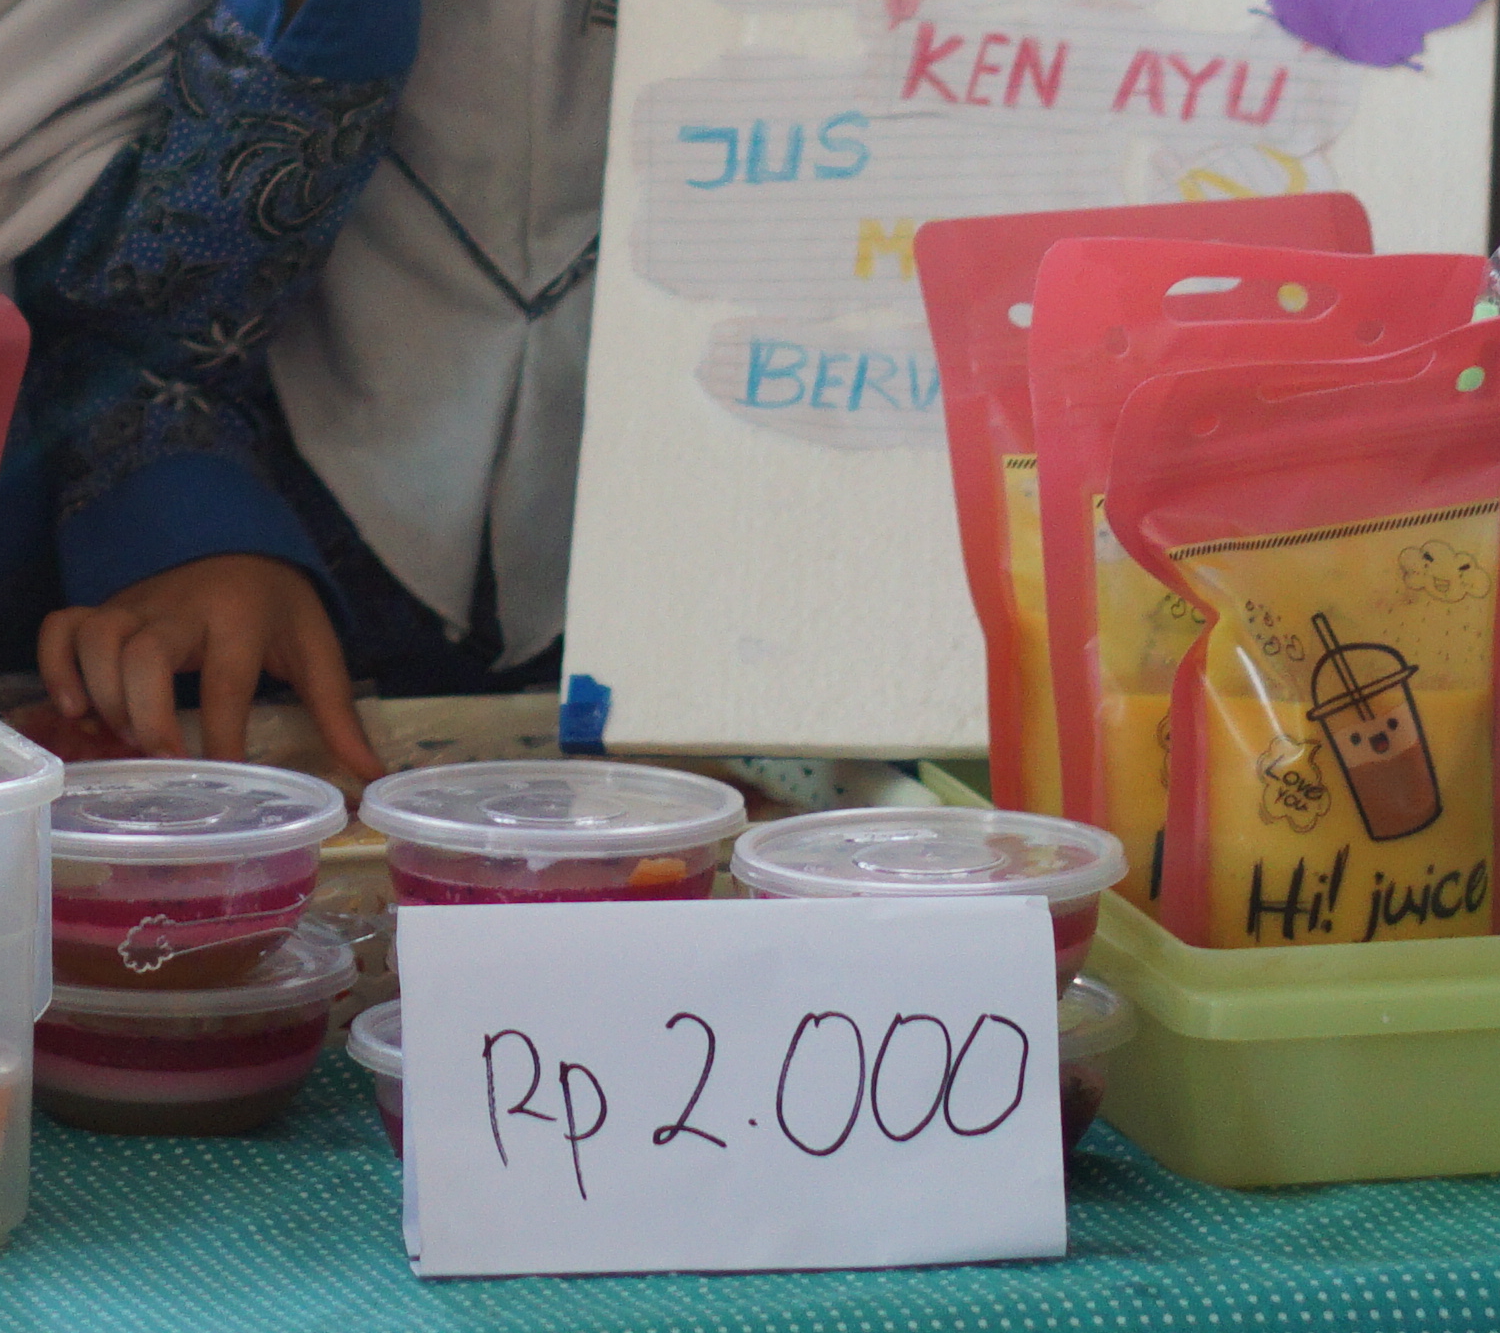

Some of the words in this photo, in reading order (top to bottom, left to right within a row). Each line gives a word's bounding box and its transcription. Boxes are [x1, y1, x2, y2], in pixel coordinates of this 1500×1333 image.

[901, 21, 1069, 109] KEN
[1112, 49, 1290, 127] AYU
[678, 110, 872, 190] JUS
[736, 337, 940, 412] BERV
[1246, 843, 1350, 943] Hi!
[1354, 858, 1489, 944] juice
[482, 1028, 608, 1201] Rp
[653, 1012, 1029, 1157] 2.000
